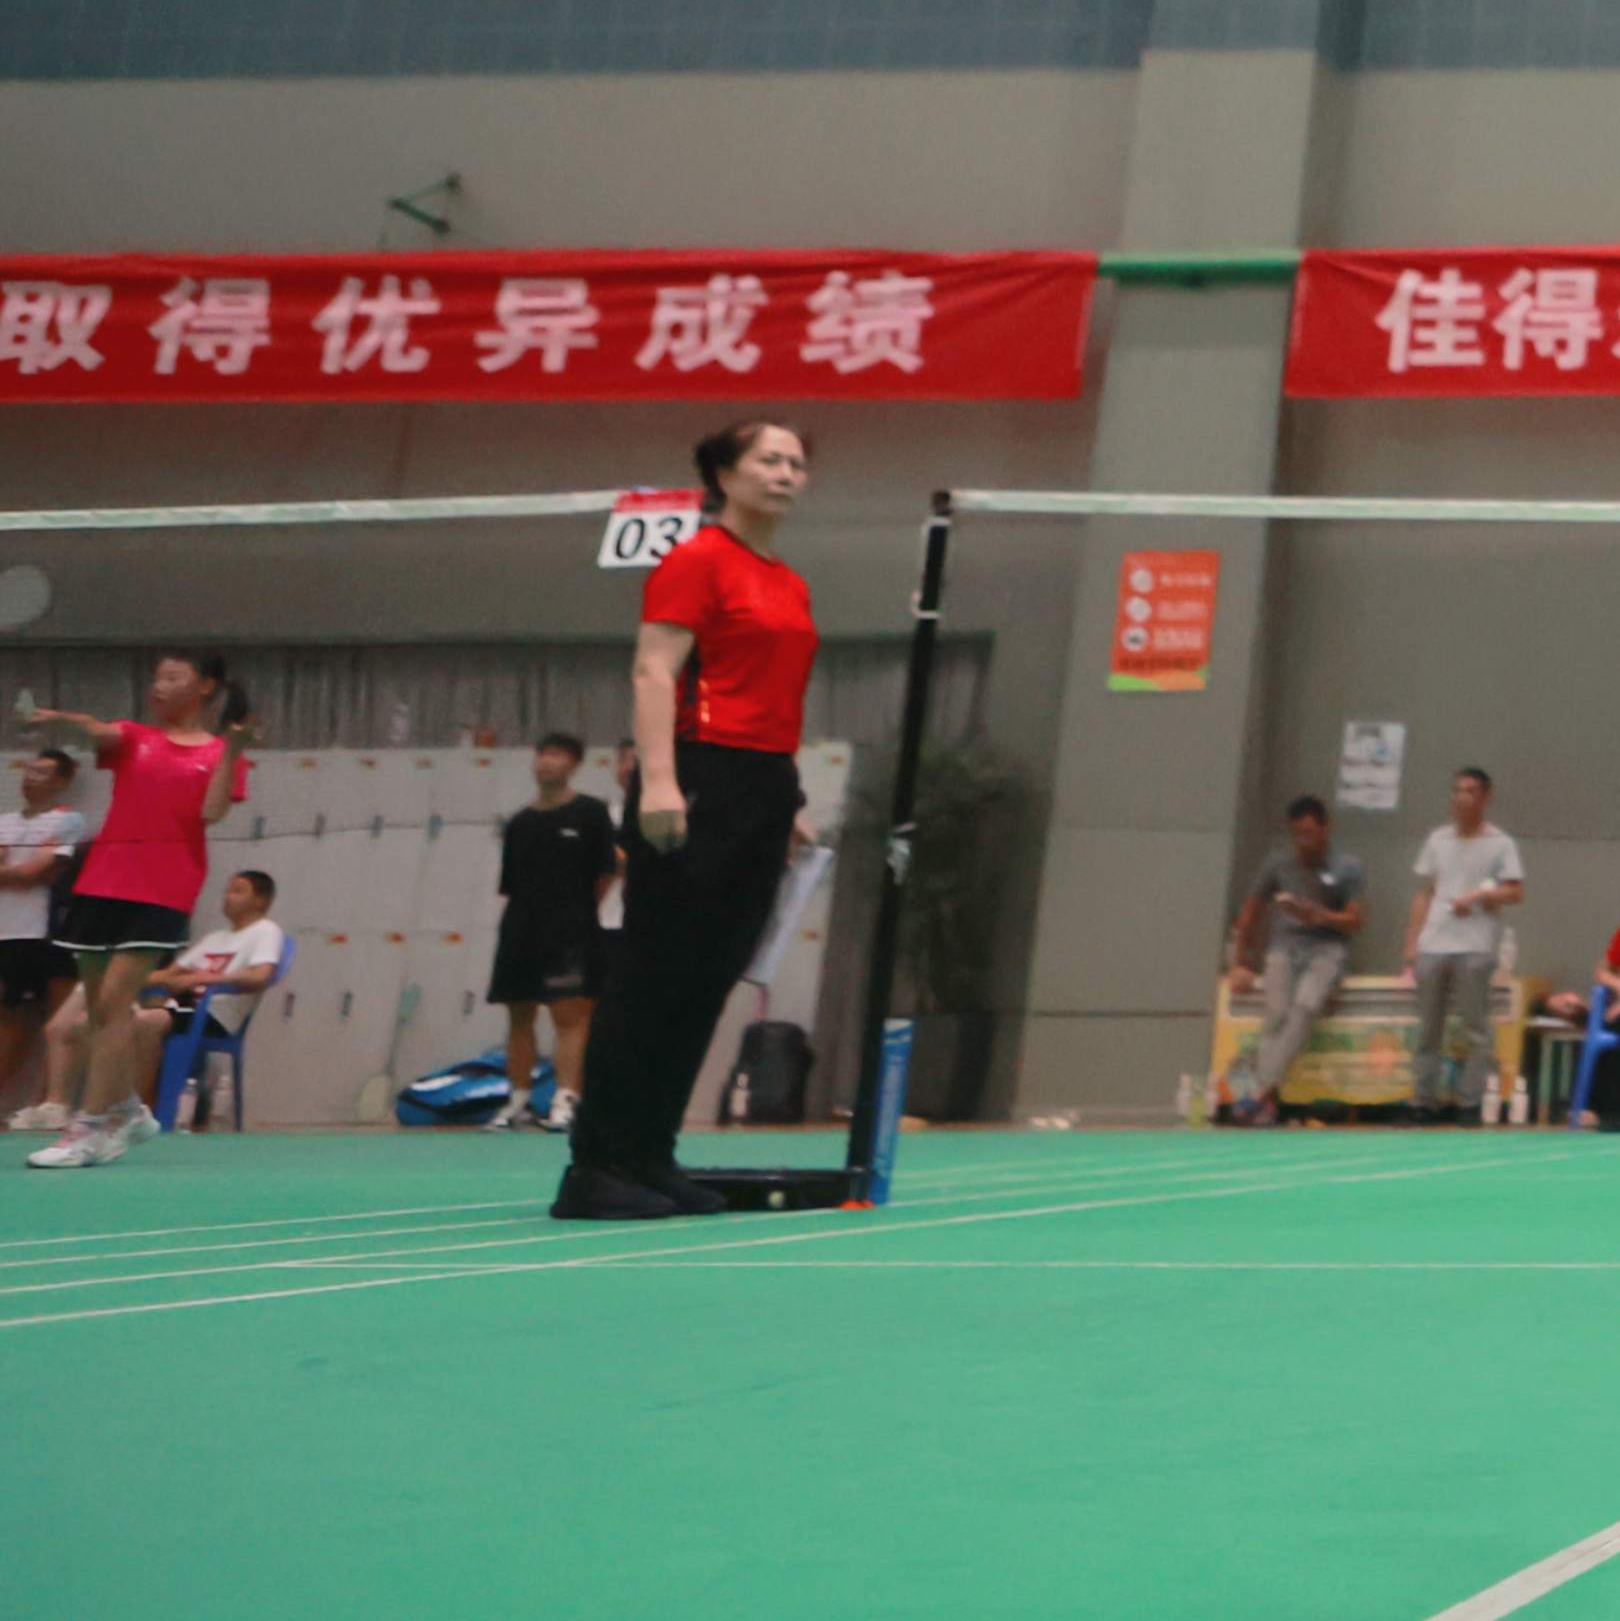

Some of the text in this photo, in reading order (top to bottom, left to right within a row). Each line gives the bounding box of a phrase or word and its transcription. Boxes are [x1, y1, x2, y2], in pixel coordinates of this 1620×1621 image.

[0, 268, 935, 374] 取得优异成绩
[615, 516, 684, 560] 03
